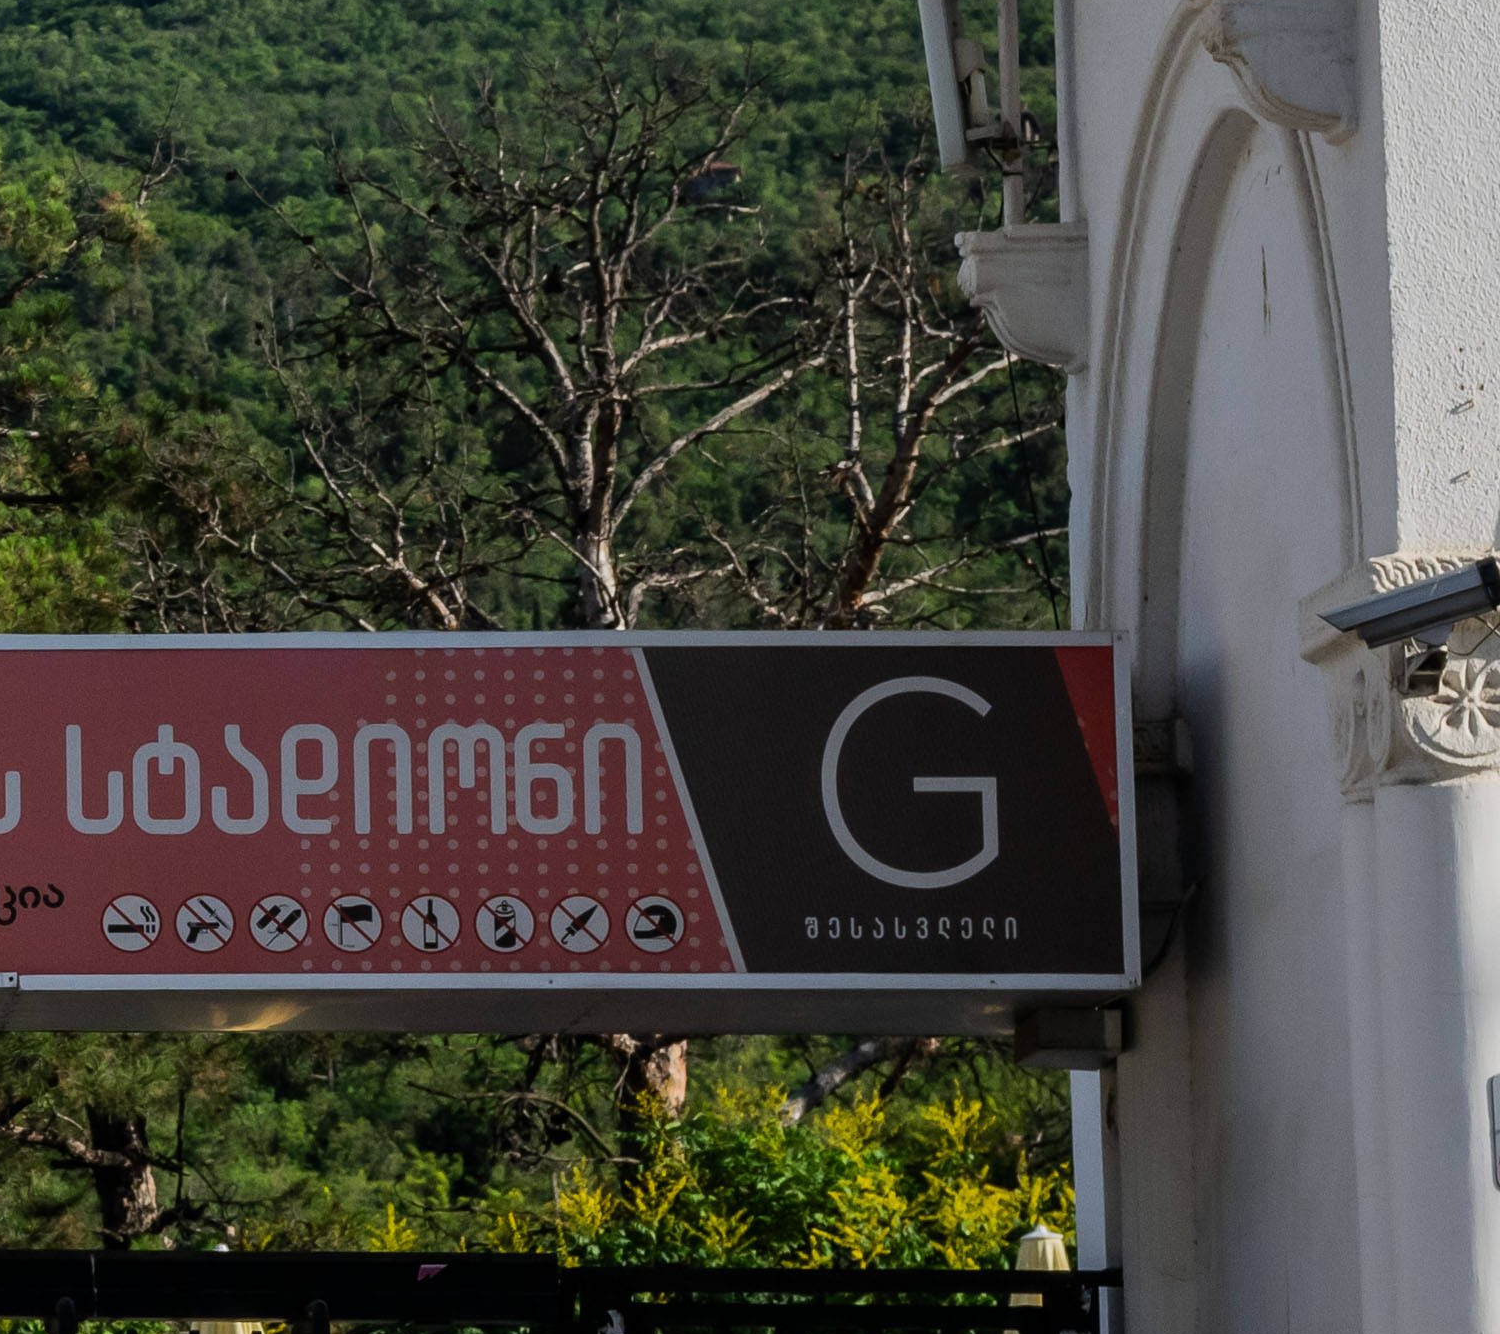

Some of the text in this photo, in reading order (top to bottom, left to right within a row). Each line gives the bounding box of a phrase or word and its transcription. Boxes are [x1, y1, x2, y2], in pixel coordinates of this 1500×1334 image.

[63, 722, 645, 835] სტადიონი
[820, 674, 1001, 891] G
[803, 914, 1019, 941] შესასვლელი
